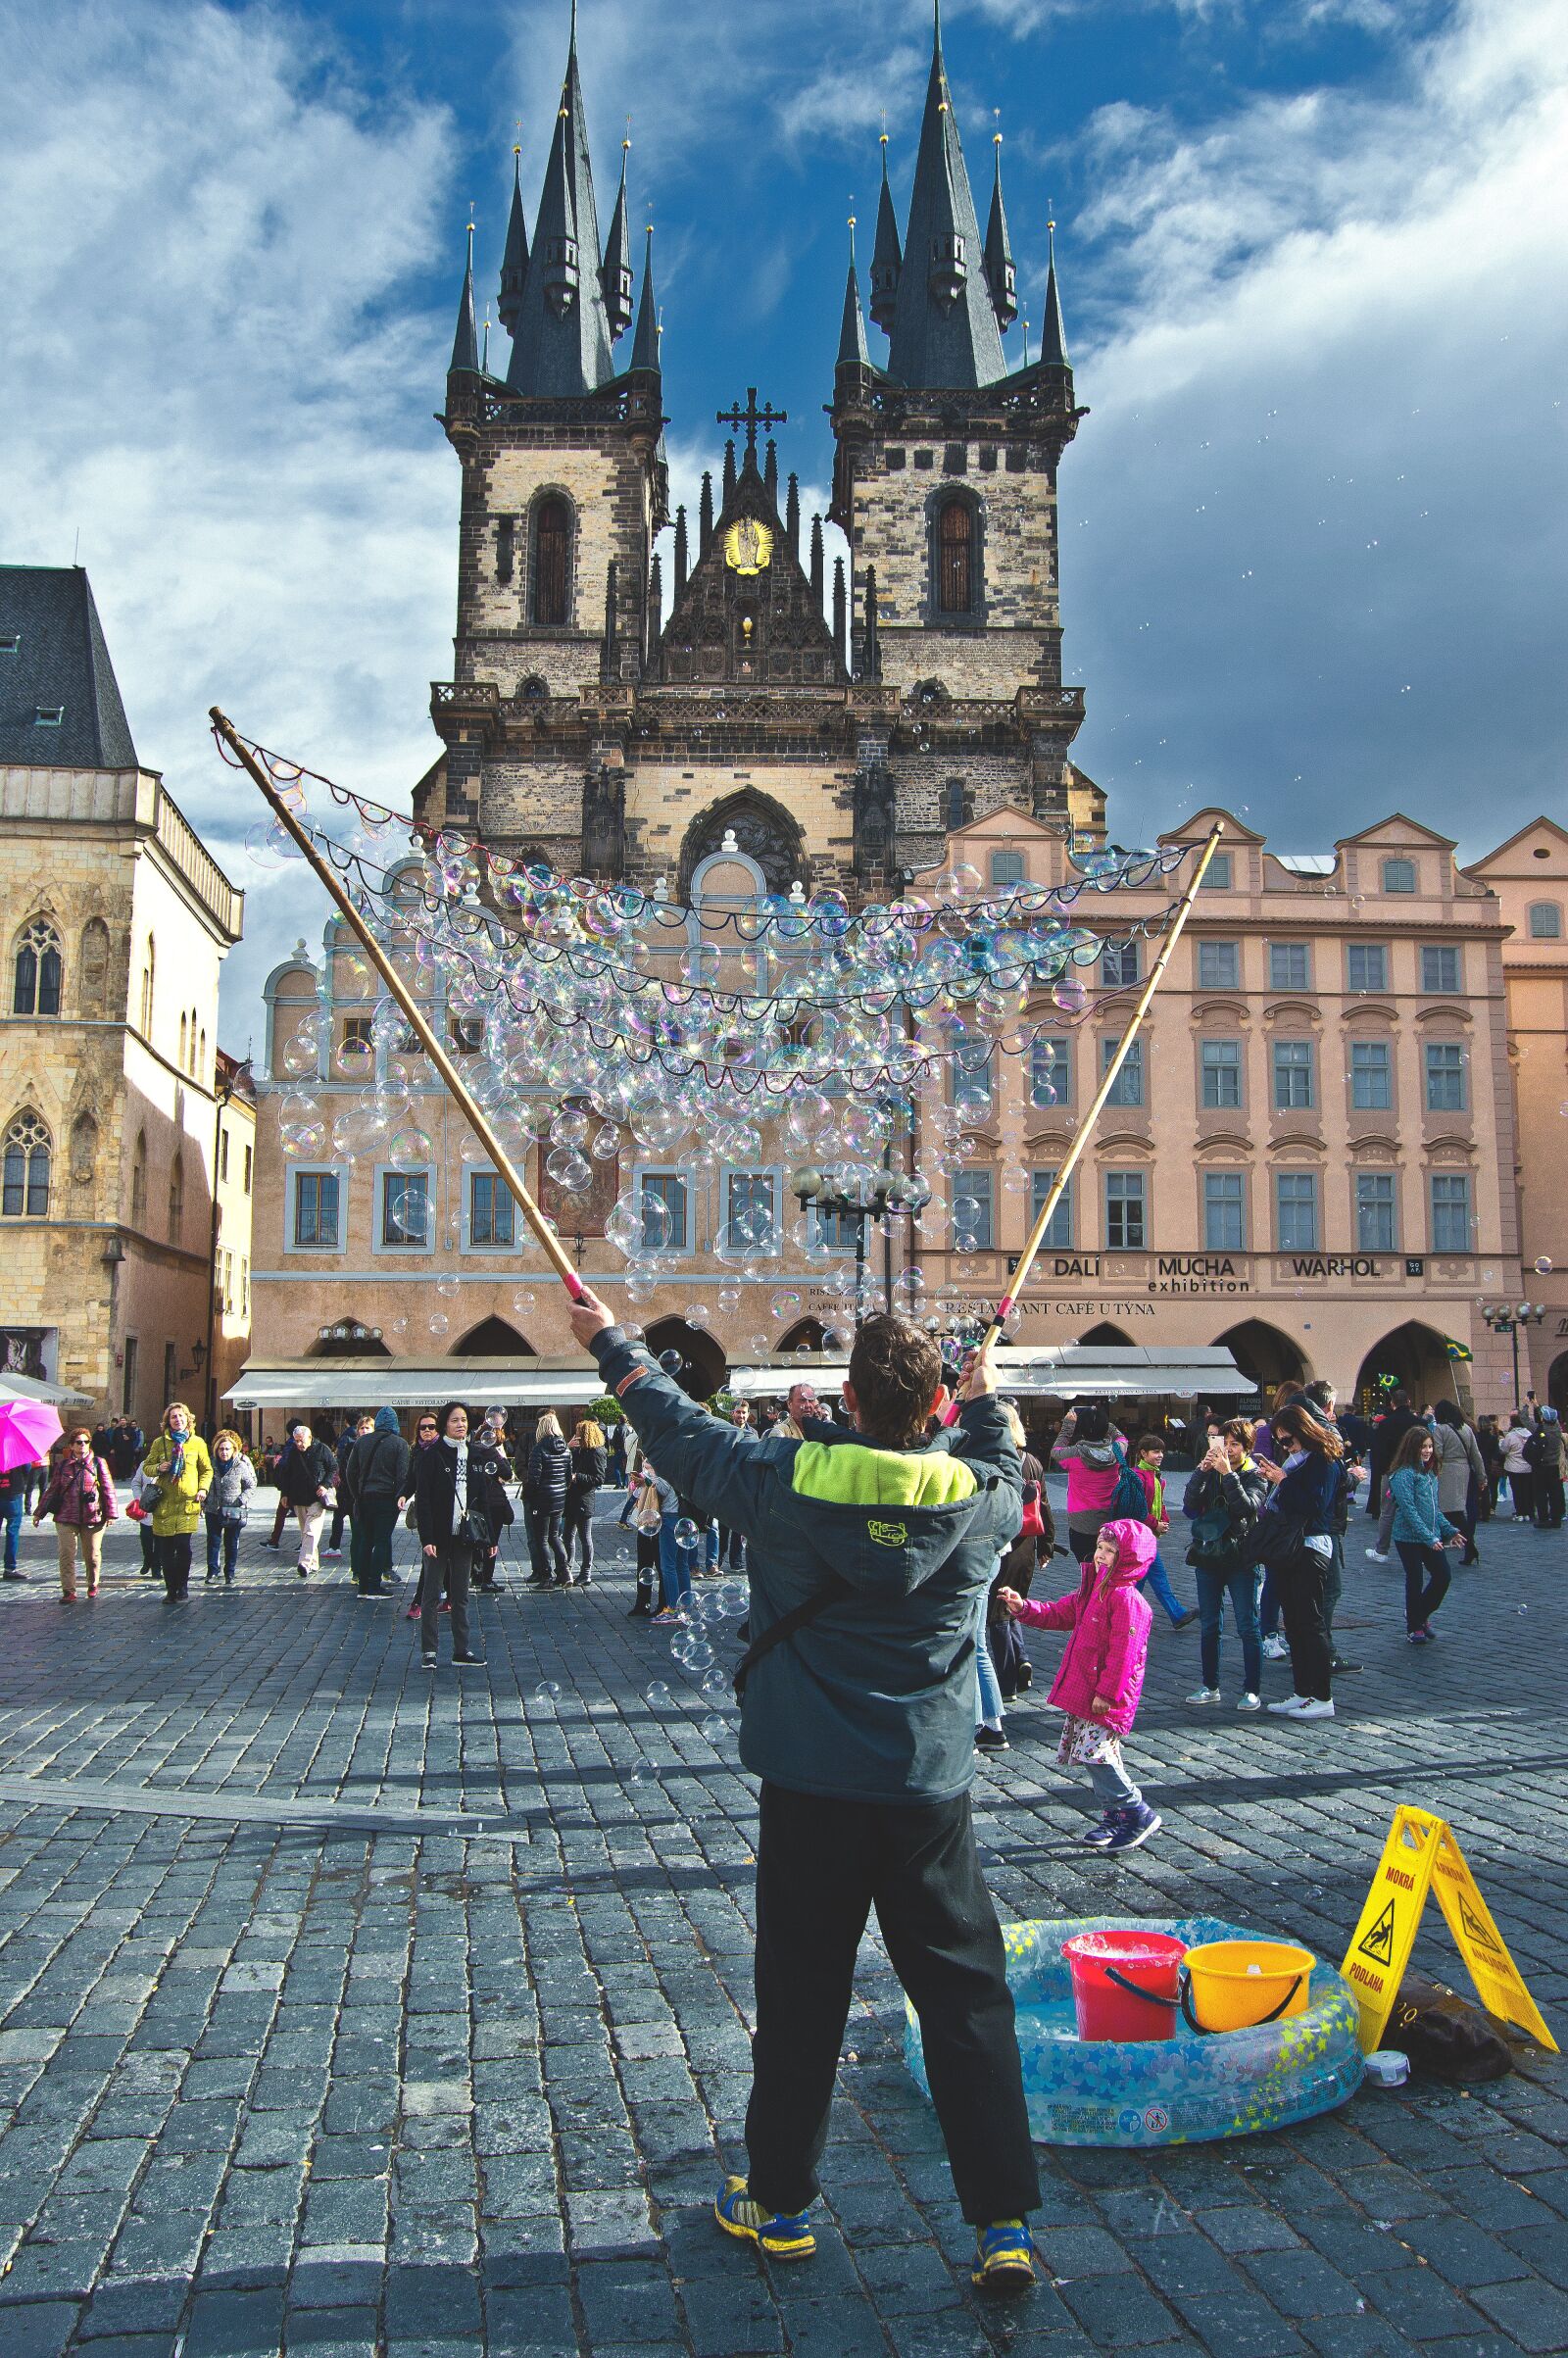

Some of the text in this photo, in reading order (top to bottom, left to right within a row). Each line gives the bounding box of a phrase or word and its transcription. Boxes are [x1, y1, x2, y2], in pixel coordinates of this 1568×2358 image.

[1054, 1256, 1100, 1277] DALÍ
[1158, 1258, 1236, 1276] MUCHA
[1293, 1258, 1381, 1277] WARHOL
[1148, 1278, 1250, 1293] exhibition
[1055, 1301, 1096, 1315] CAFÉ
[1100, 1302, 1110, 1315] U
[1113, 1301, 1155, 1315] TÝNA
[1386, 1866, 1416, 1891] MOKRÁ
[1349, 1962, 1384, 1994] PODLAHA
